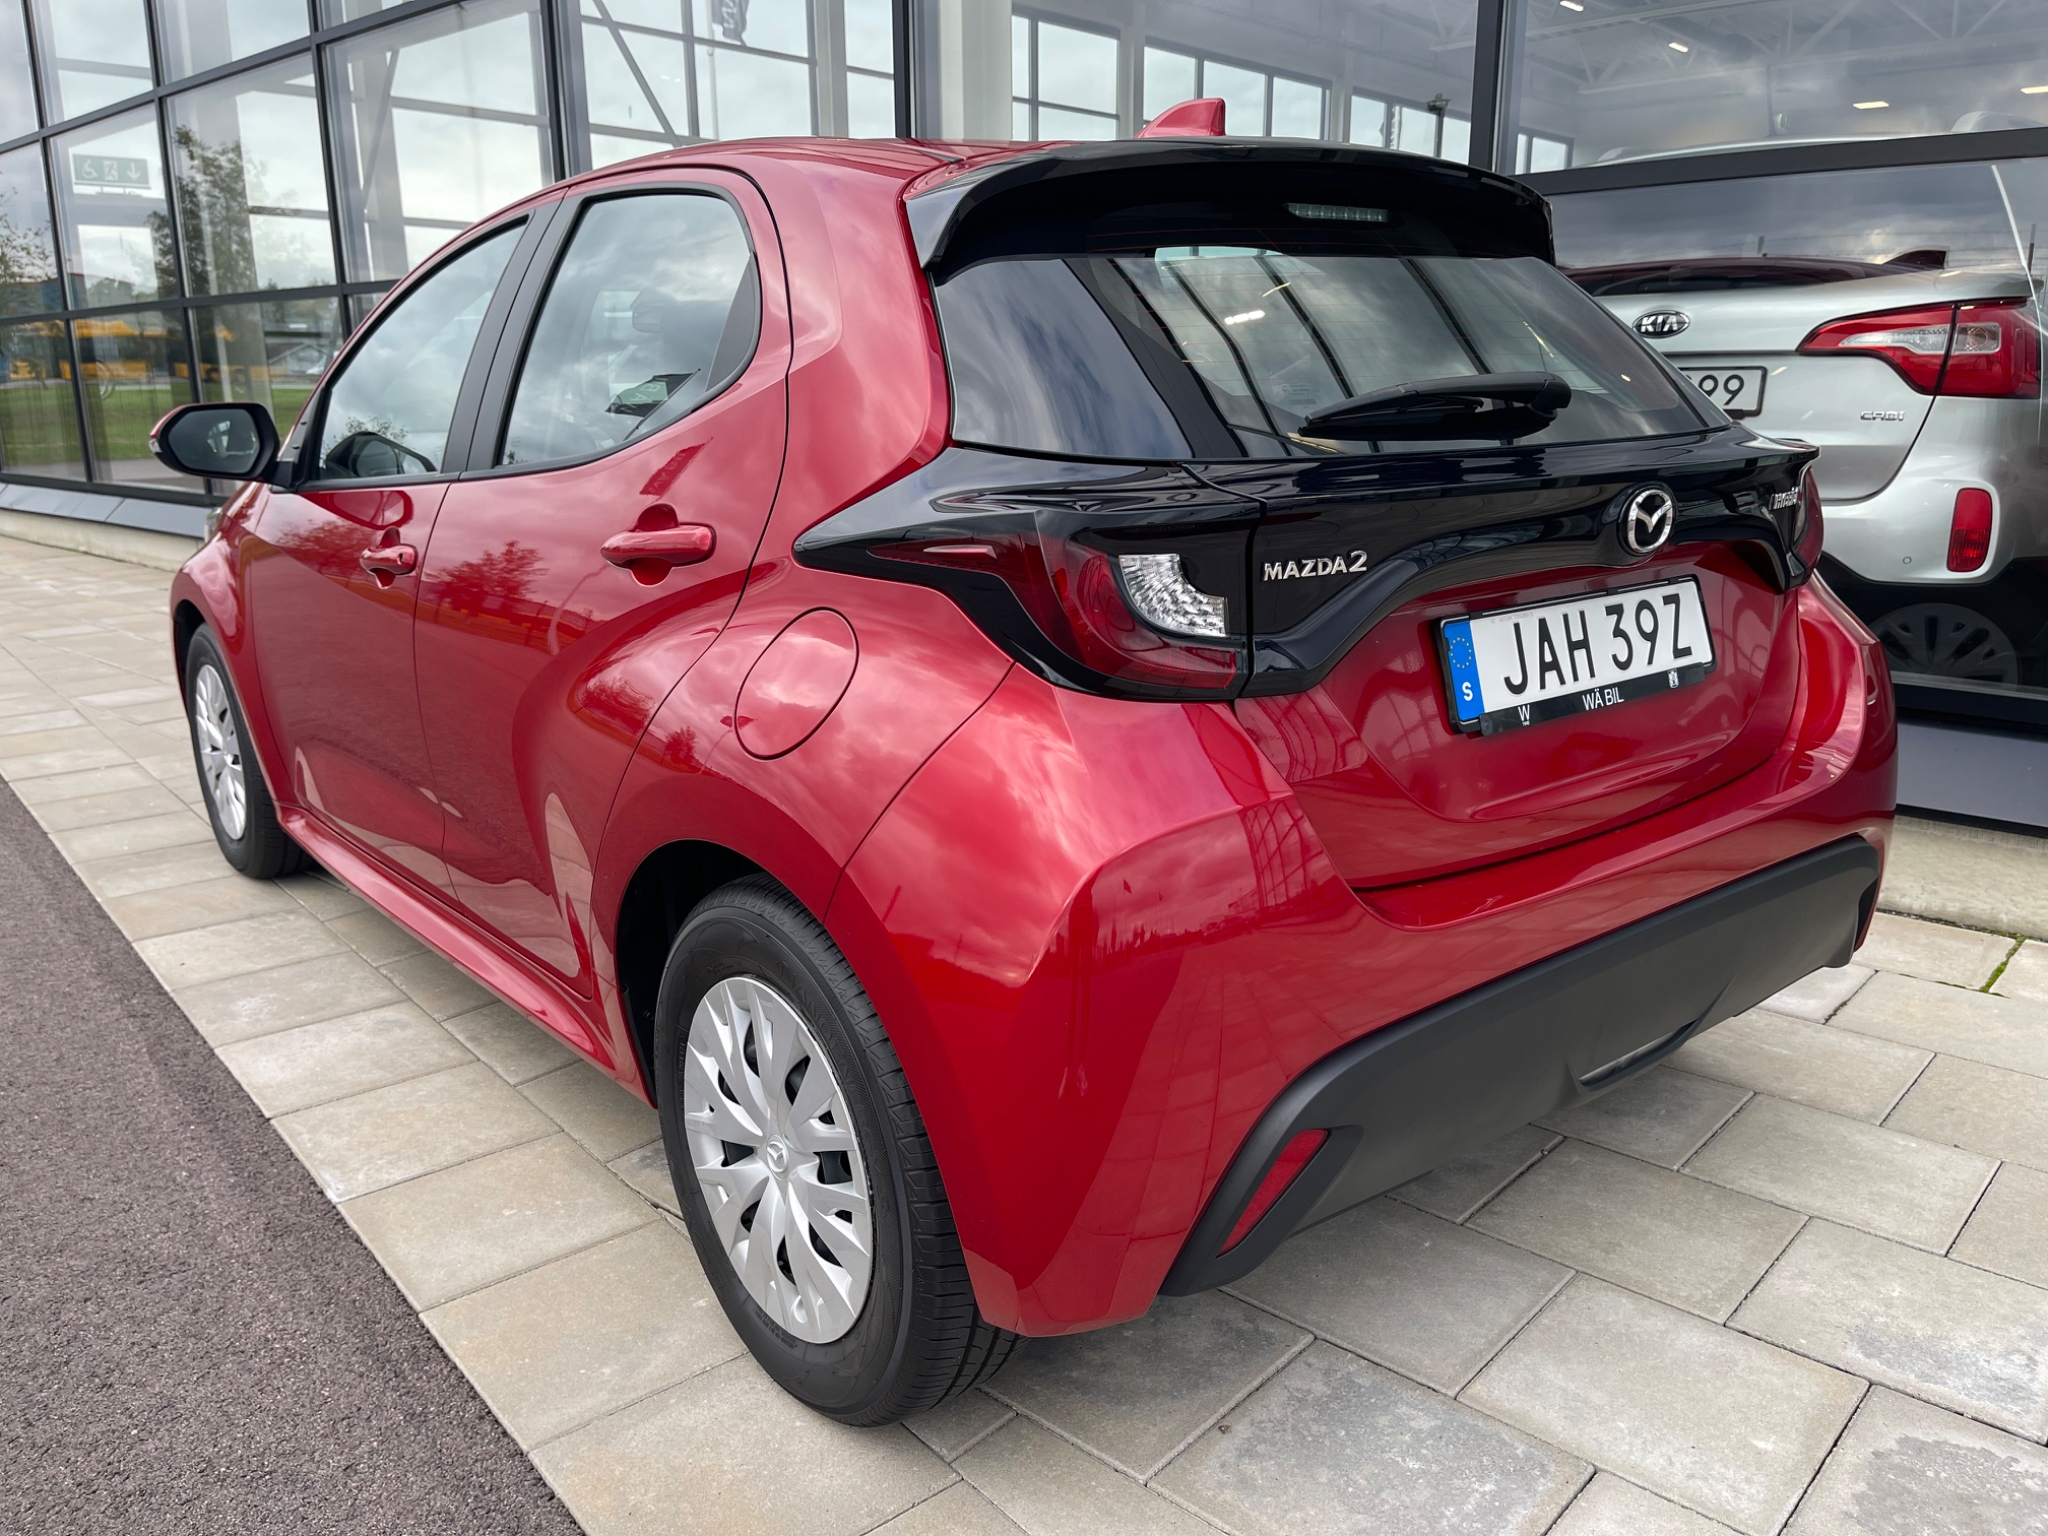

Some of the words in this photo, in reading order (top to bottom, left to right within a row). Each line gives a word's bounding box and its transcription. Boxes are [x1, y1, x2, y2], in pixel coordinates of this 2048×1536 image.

[1640, 315, 1678, 332] KIA
[1686, 374, 1745, 406] 99
[1264, 550, 1367, 581] MAZDA2
[1503, 610, 1595, 695] JAH
[1604, 593, 1693, 671] 39Z
[1461, 682, 1474, 701] S
[1582, 688, 1604, 710] WÄ
[1604, 687, 1625, 706] BIL
[1517, 704, 1530, 721] W
